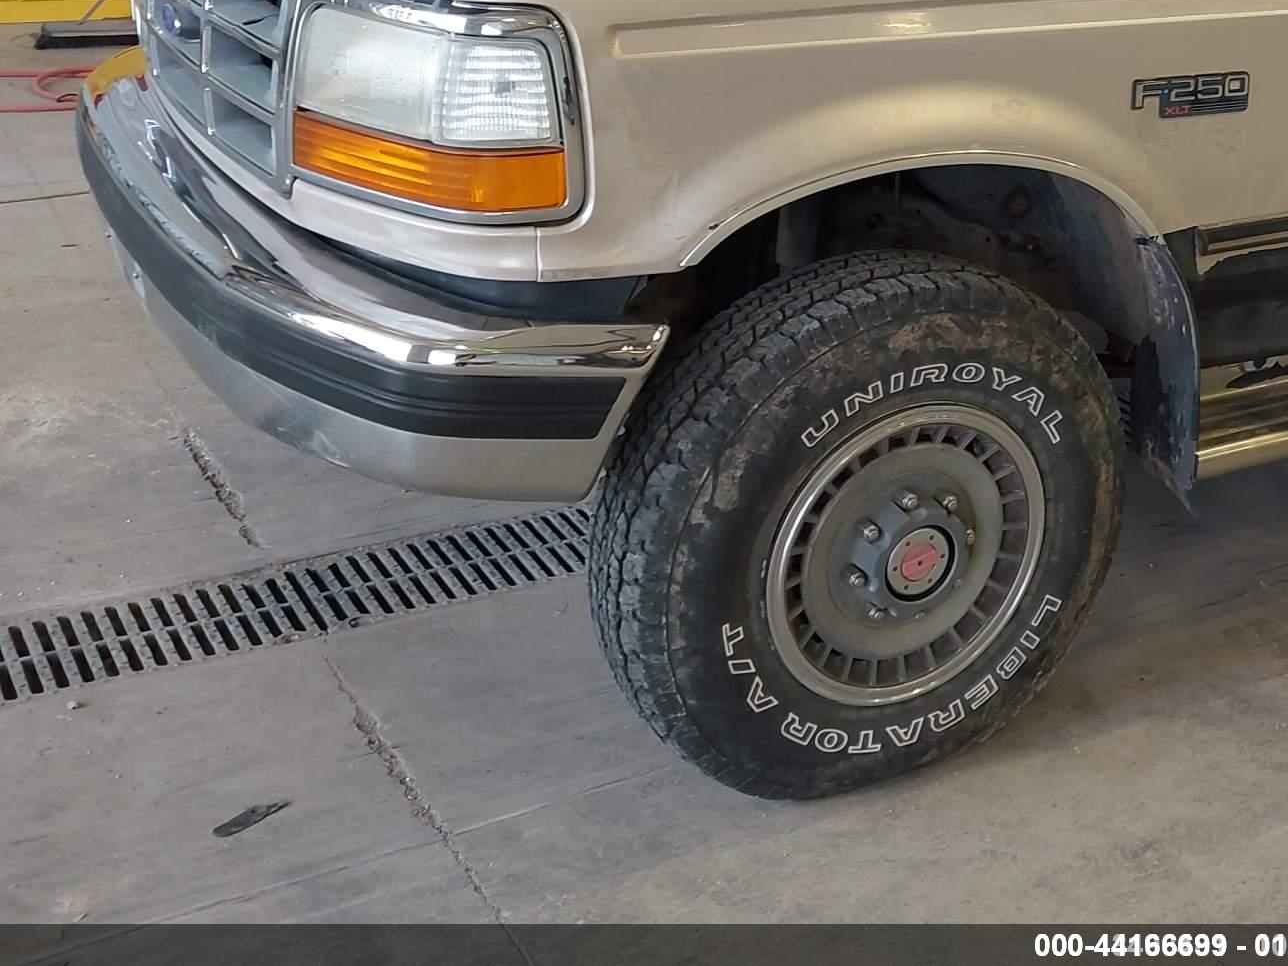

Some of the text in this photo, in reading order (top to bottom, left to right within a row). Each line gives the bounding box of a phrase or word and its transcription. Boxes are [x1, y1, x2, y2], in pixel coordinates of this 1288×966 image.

[1164, 105, 1191, 115] XLT
[801, 362, 1064, 448] UNIROYAL
[781, 594, 1063, 754] LIBERATOR
